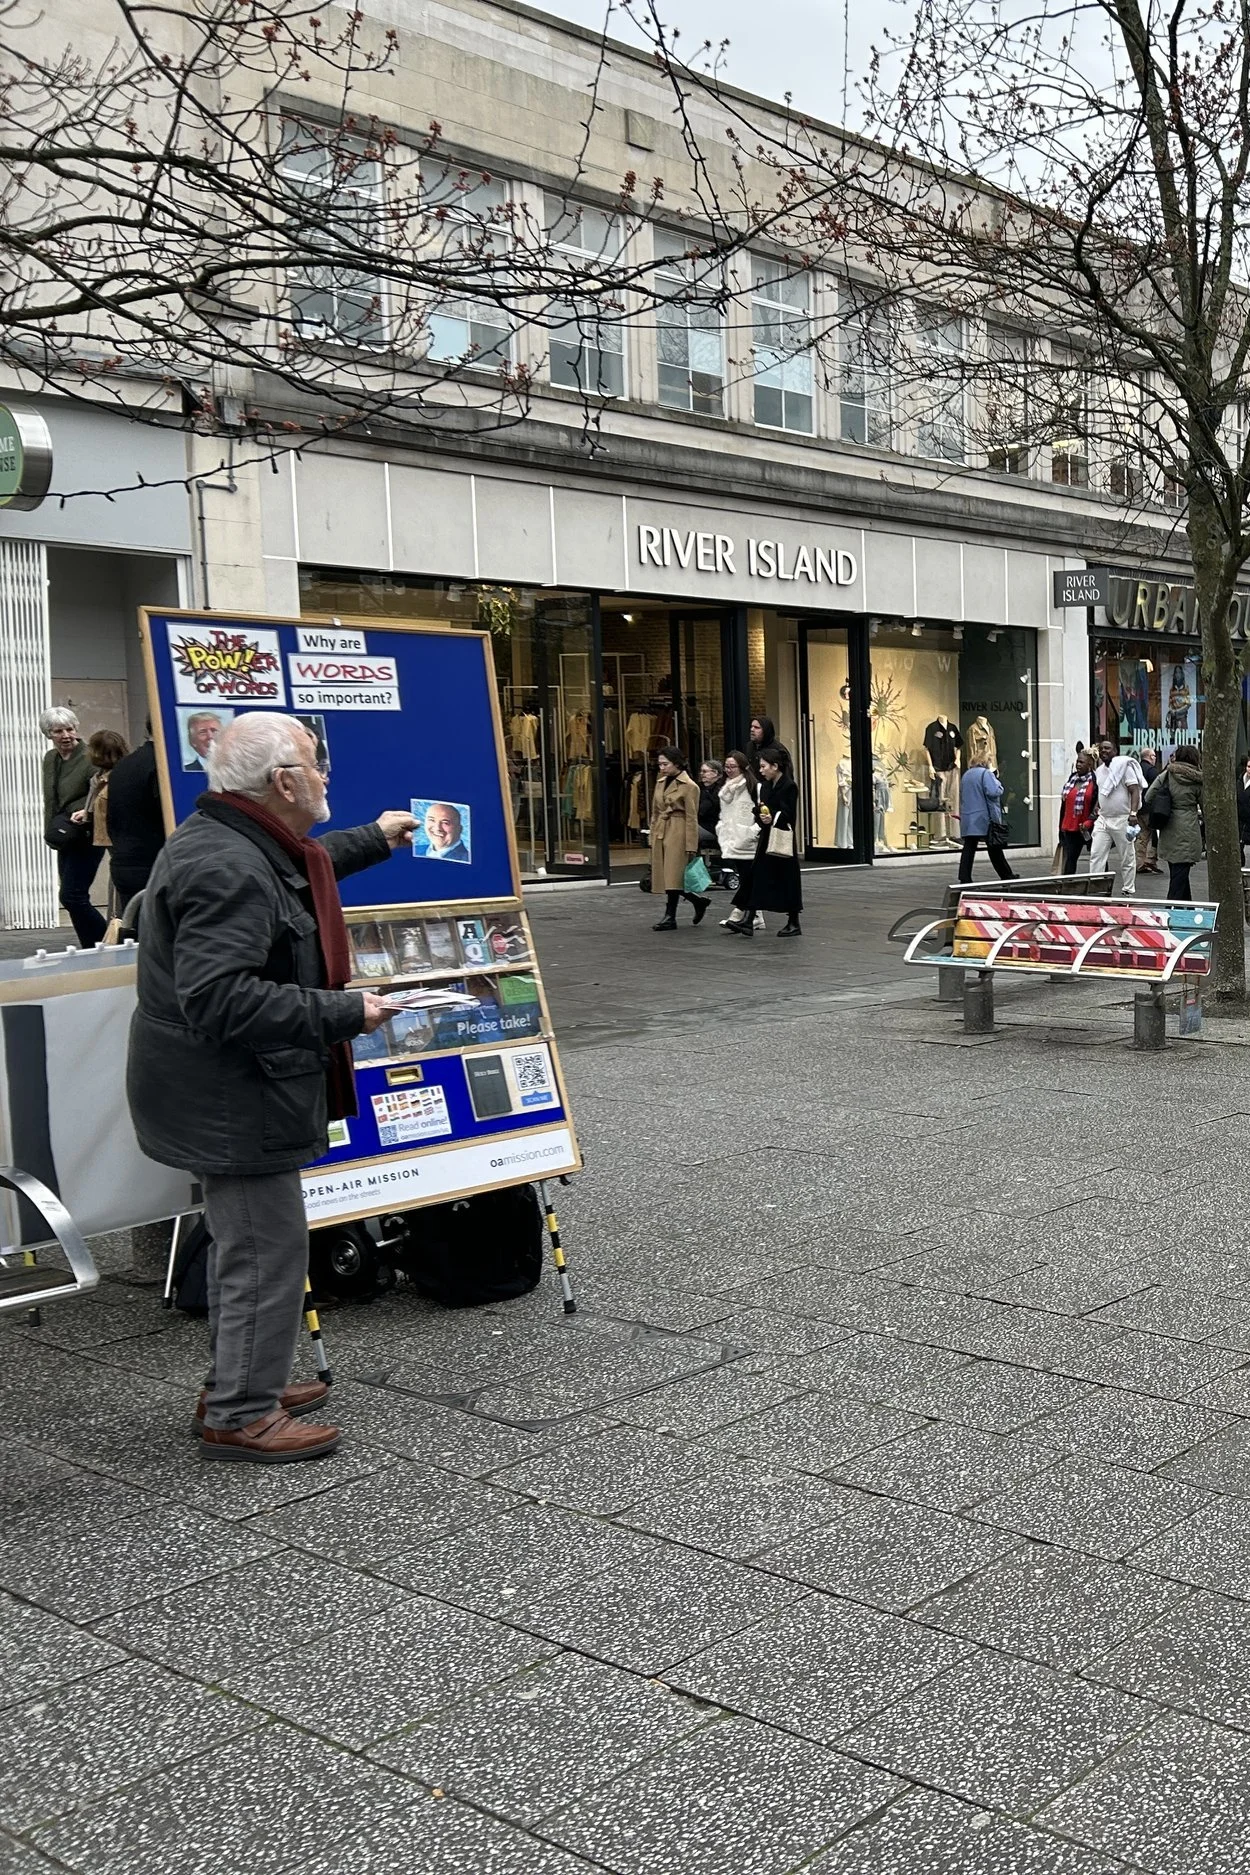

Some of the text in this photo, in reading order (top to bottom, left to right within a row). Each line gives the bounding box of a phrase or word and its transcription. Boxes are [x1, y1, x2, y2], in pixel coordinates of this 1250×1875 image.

[638, 525, 858, 585] RIVER ISLAND
[1066, 575, 1096, 588] RIVER
[1062, 588, 1100, 602] ISLAND
[209, 630, 248, 650] THE
[303, 635, 361, 651] Why are
[296, 662, 394, 681] WORDS
[197, 680, 279, 696] OF WORDS
[298, 690, 392, 706] so important?
[962, 701, 1024, 712] RIVER ISLAND
[1133, 728, 1171, 751] URBAN
[456, 1013, 531, 1036] Please take!
[398, 1115, 448, 1133] Read online!
[489, 1145, 565, 1168] oamission.com
[302, 1168, 420, 1199] OPEN-AIR MISSION
[349, 1191, 359, 1200] the
